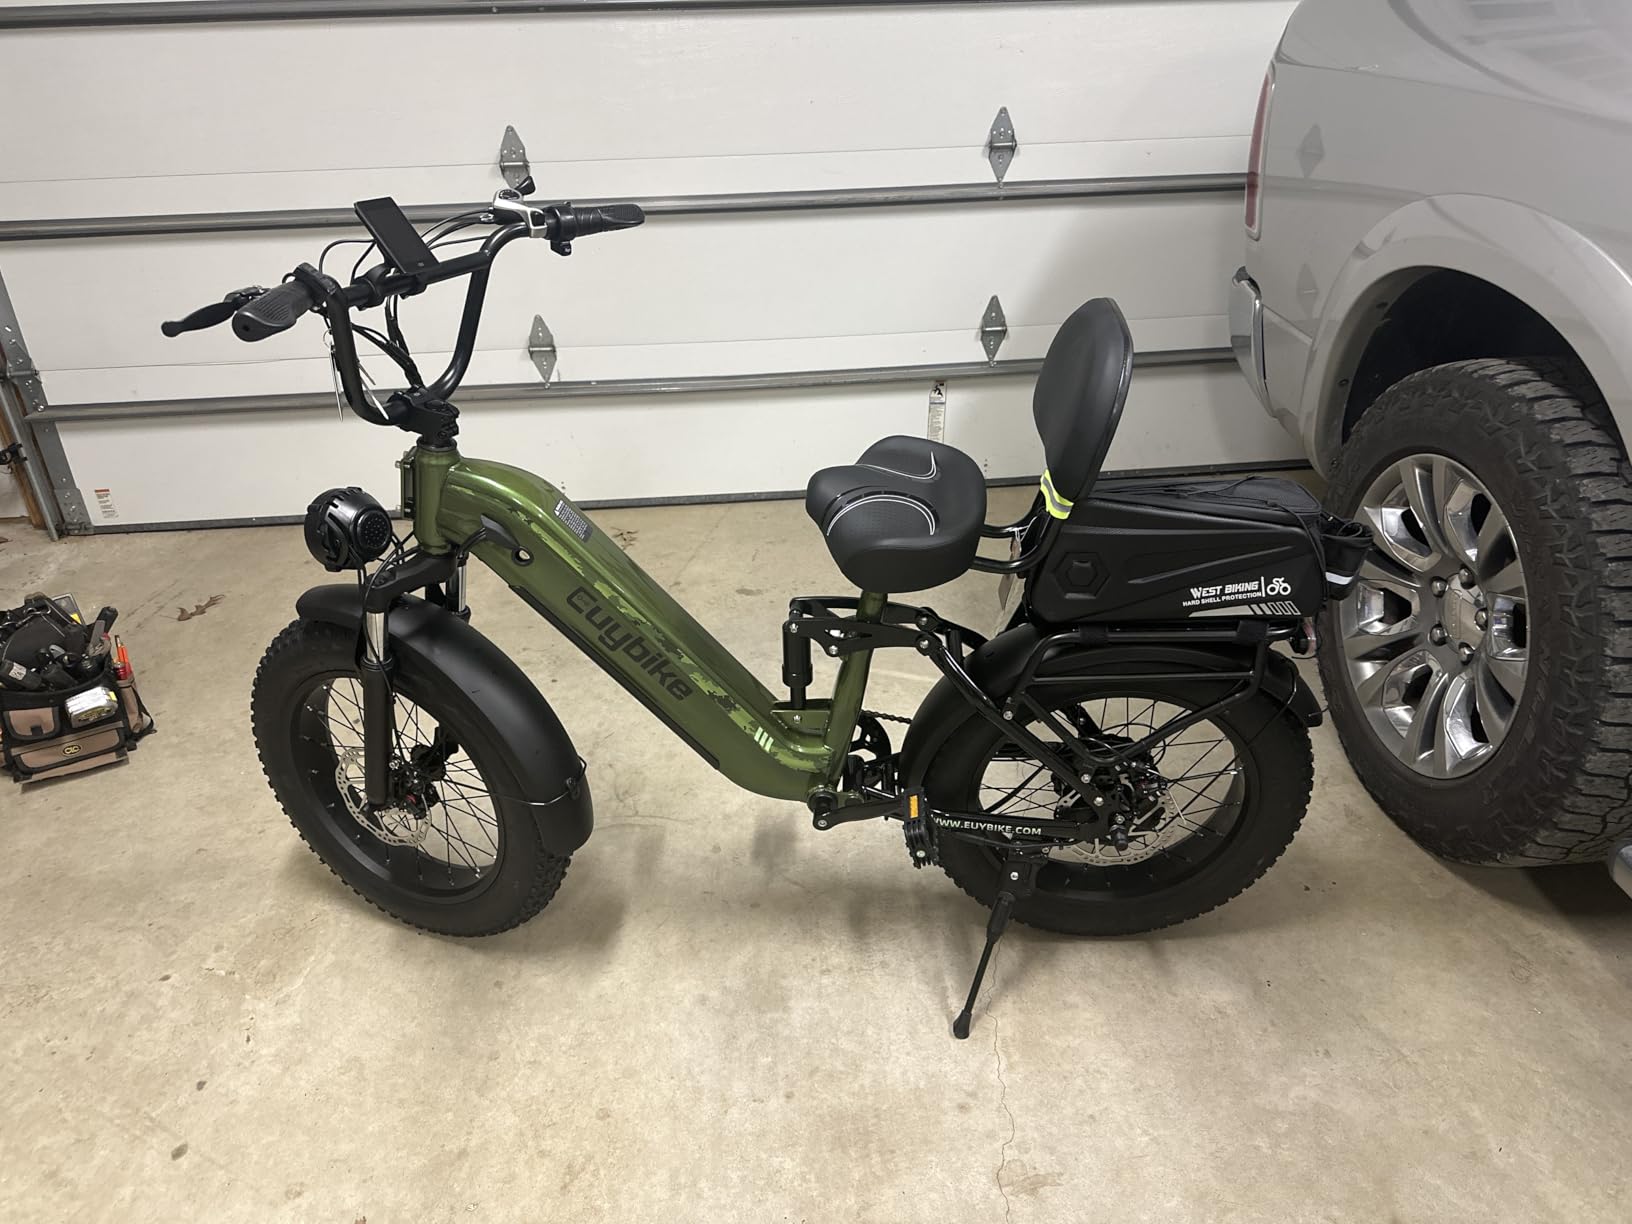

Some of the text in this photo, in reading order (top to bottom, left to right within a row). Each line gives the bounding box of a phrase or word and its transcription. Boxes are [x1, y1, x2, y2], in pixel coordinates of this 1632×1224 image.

[1190, 581, 1260, 599] WEST BIKING
[1182, 591, 1262, 607] HARD SHELL PROTECTION
